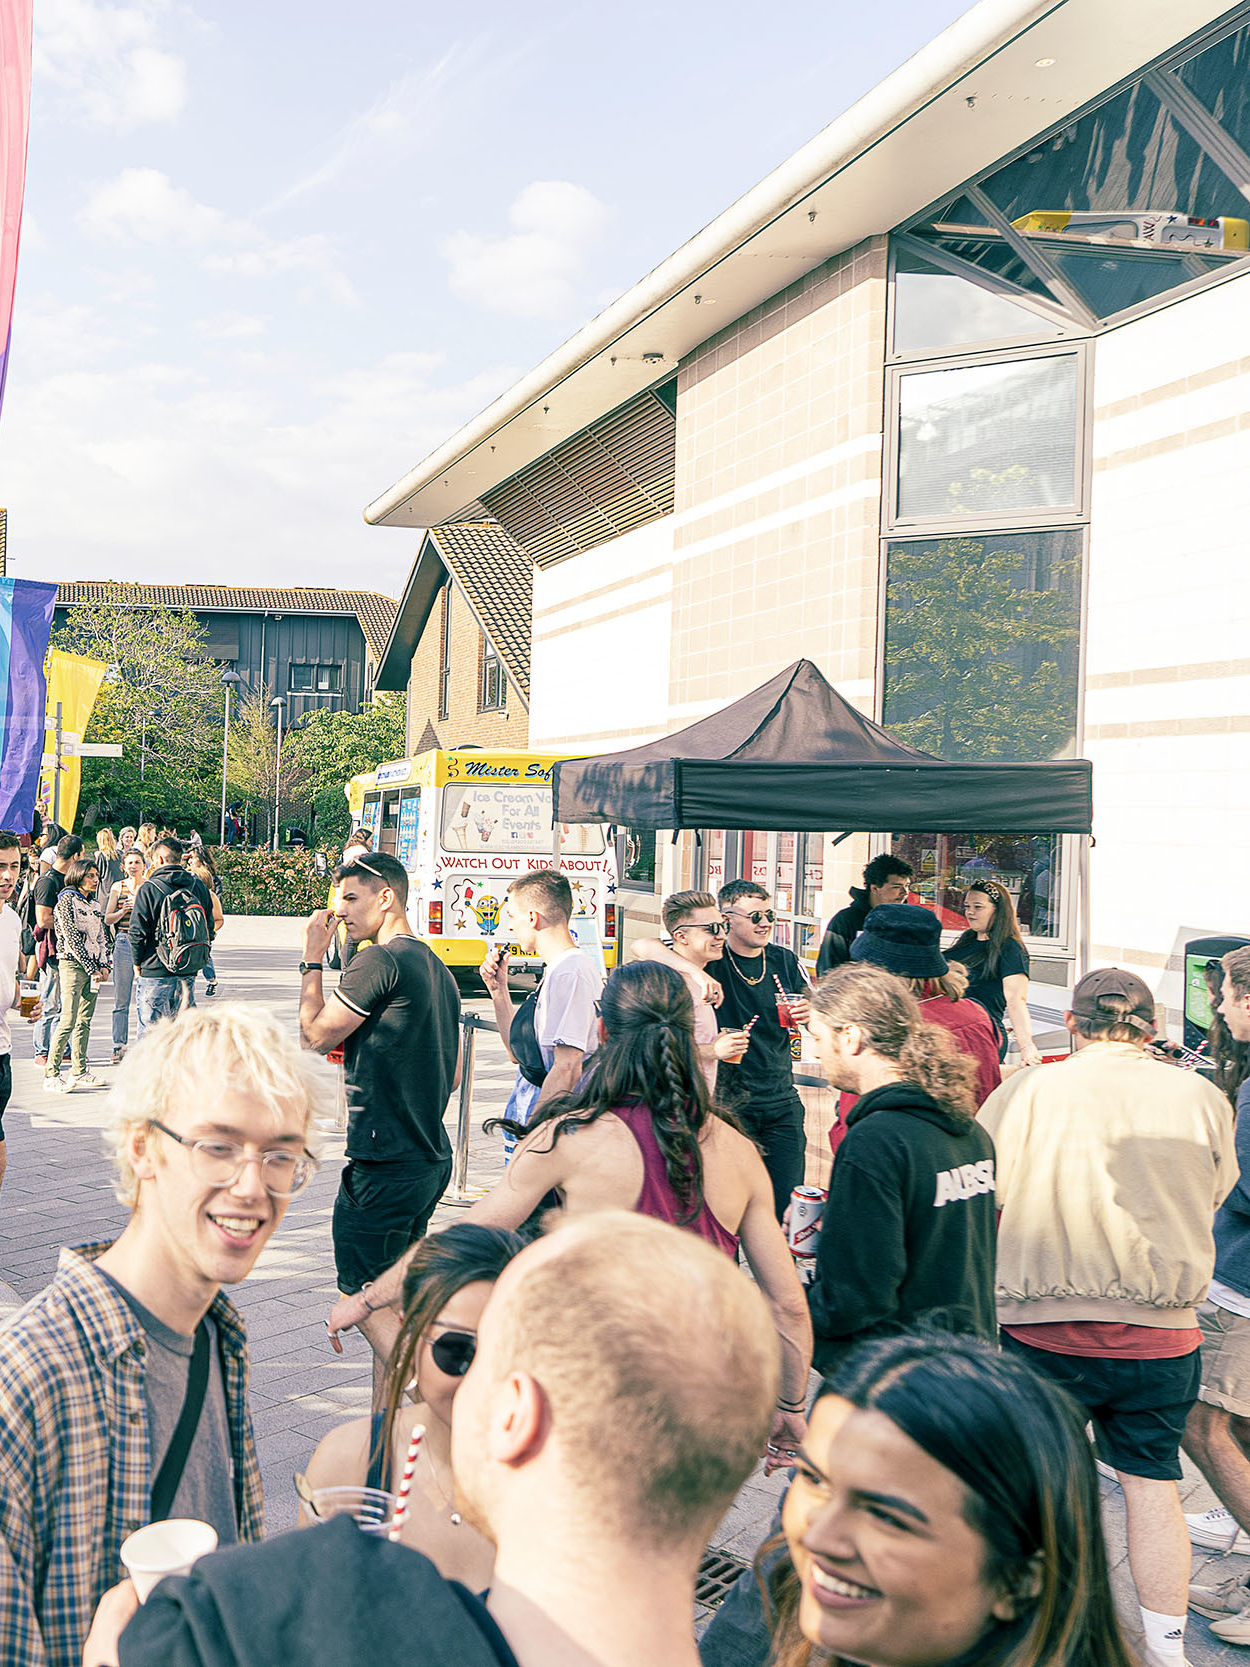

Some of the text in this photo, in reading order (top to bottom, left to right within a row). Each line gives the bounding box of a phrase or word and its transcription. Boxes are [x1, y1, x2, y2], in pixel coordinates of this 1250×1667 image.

[465, 761, 519, 778] Mister
[473, 790, 491, 802] Ice
[494, 790, 533, 803] Cream
[502, 804, 539, 817] For All
[502, 817, 542, 831] Events
[441, 856, 487, 869] WATCH
[492, 857, 521, 870] OUT
[559, 859, 608, 873] ABOUT!
